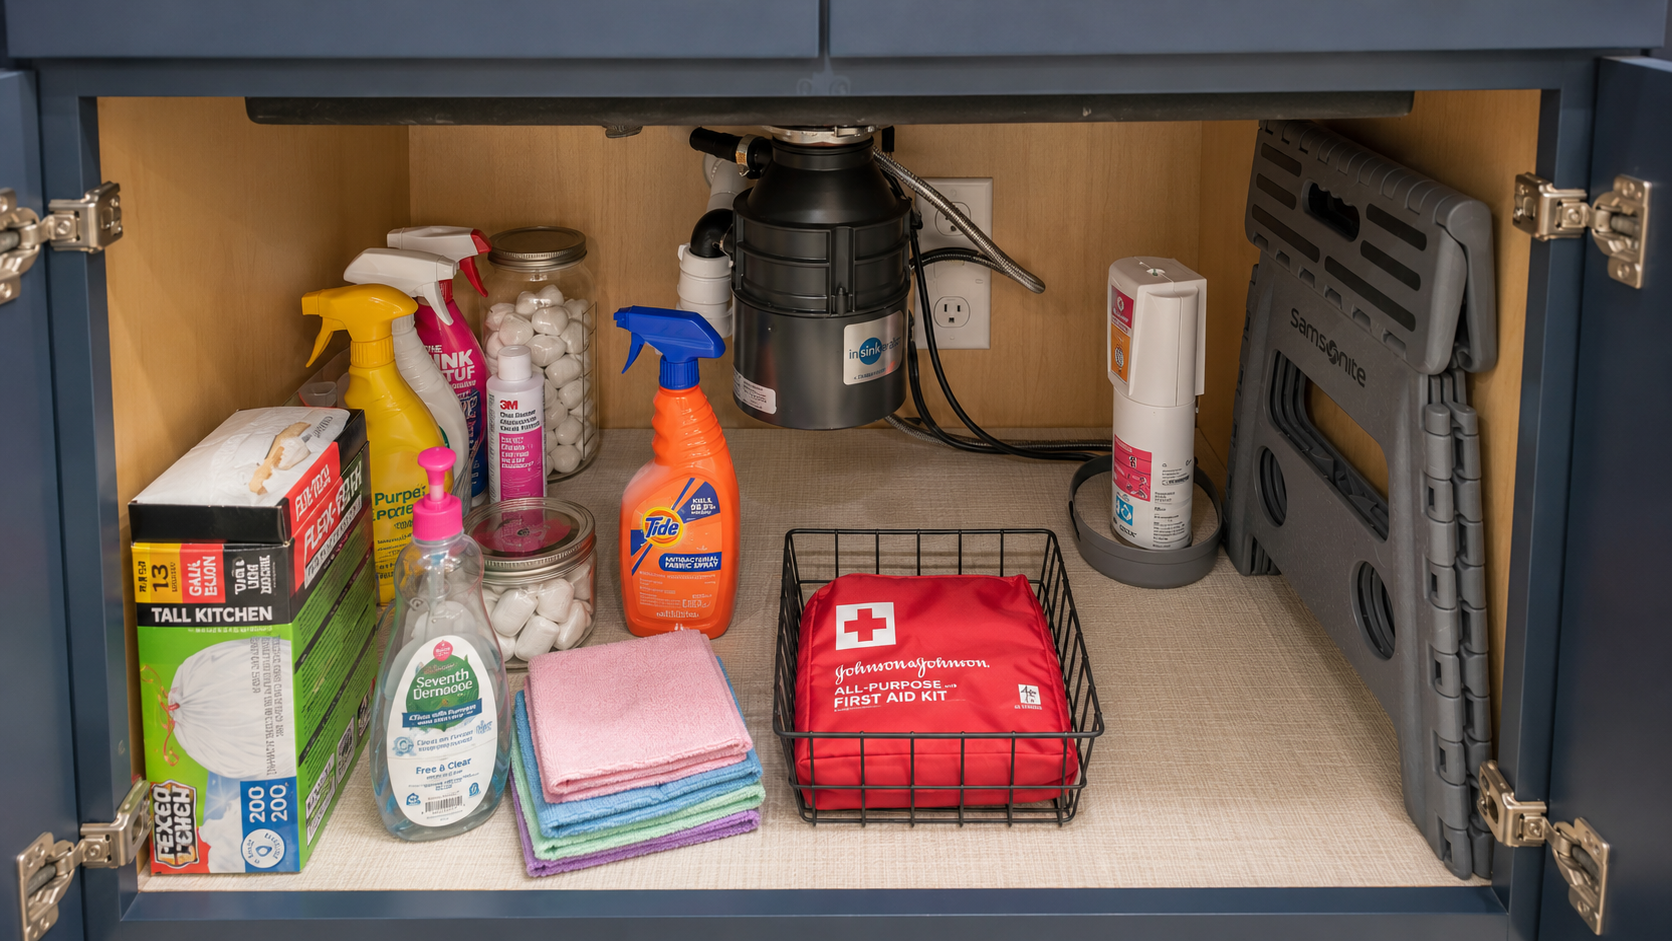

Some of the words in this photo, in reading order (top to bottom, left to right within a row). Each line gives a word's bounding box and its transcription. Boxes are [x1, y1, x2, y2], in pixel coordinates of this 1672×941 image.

[433, 349, 474, 370] INK
[442, 365, 476, 382] TUF
[499, 400, 519, 410] 3M
[644, 516, 680, 539] Tide
[152, 564, 169, 592] 13
[151, 607, 192, 623] TALL
[195, 605, 273, 622] KITCHEN
[416, 668, 469, 688] Seventh
[834, 680, 942, 696] ALL-PURPOSE
[834, 693, 882, 708] FIRST
[886, 691, 916, 703] AID
[921, 690, 948, 702] KIT
[416, 766, 437, 775] Free
[447, 758, 472, 770] Clear
[248, 786, 266, 823] 200
[269, 784, 288, 822] 200
